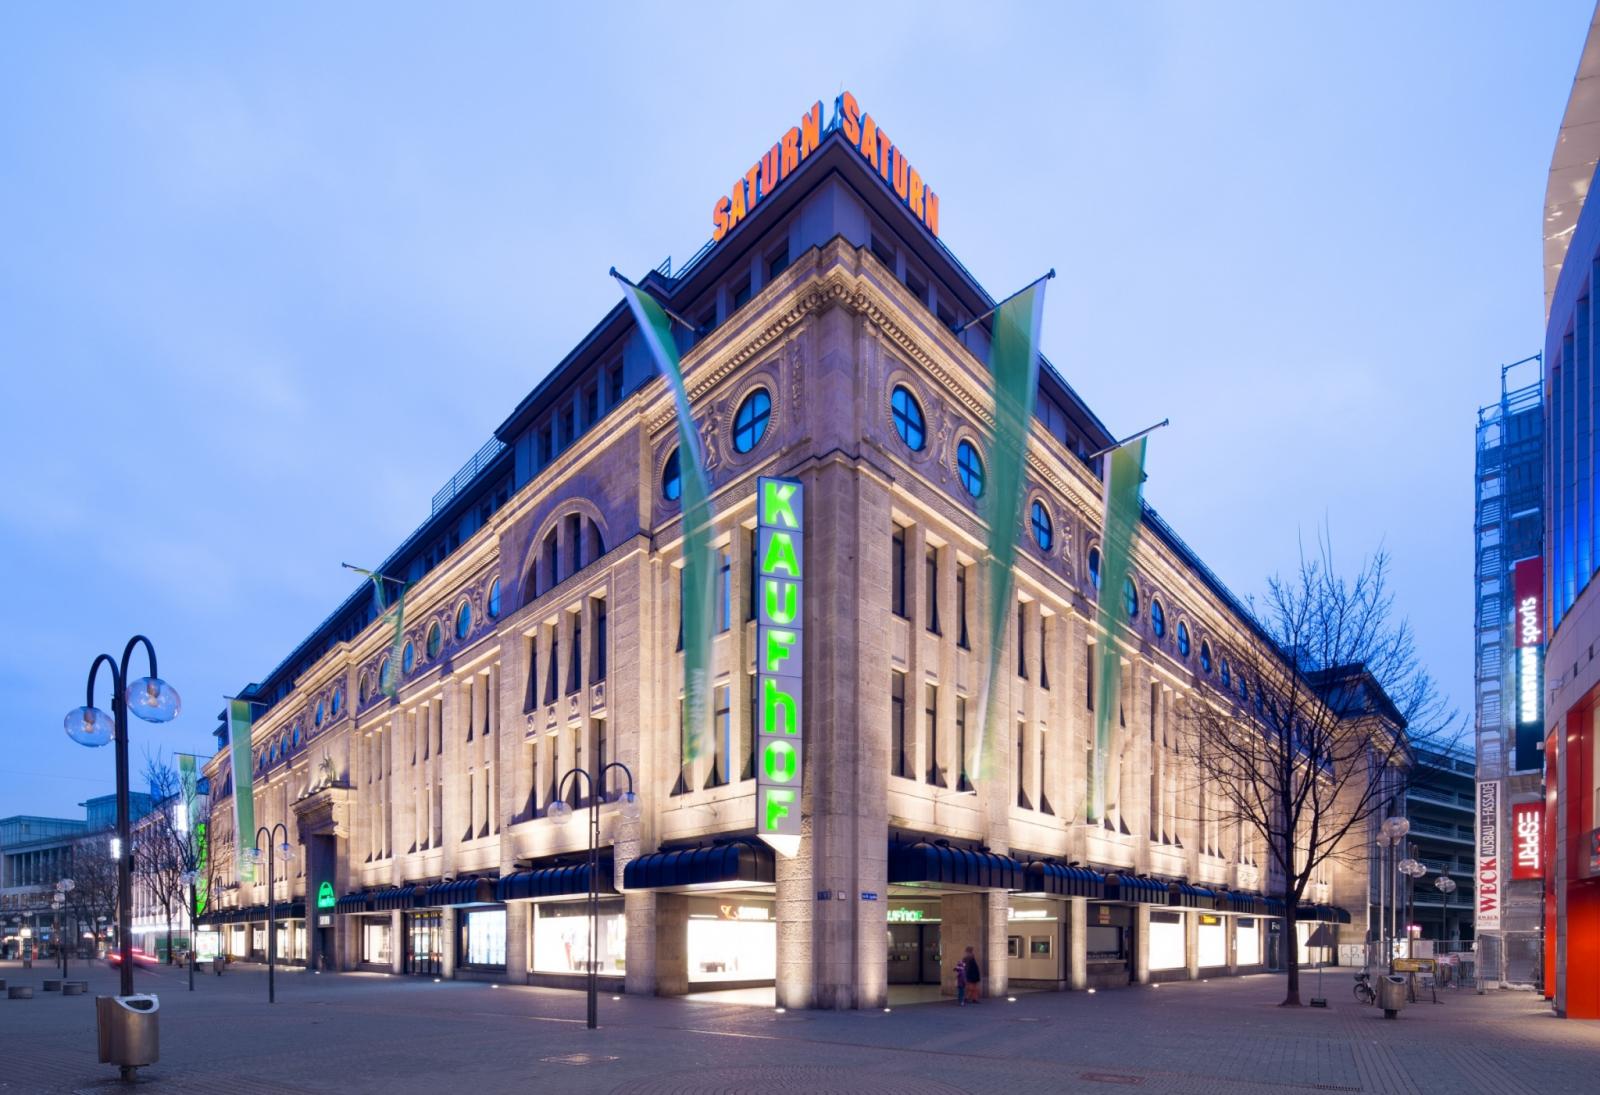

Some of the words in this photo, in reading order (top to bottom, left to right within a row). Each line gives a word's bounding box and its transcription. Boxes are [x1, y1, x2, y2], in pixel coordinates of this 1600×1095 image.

[713, 101, 820, 242] SATURN
[842, 91, 939, 236] SATURN
[1519, 597, 1541, 644] sports
[1517, 811, 1540, 870] ESPRIT
[1479, 857, 1497, 913] WECK
